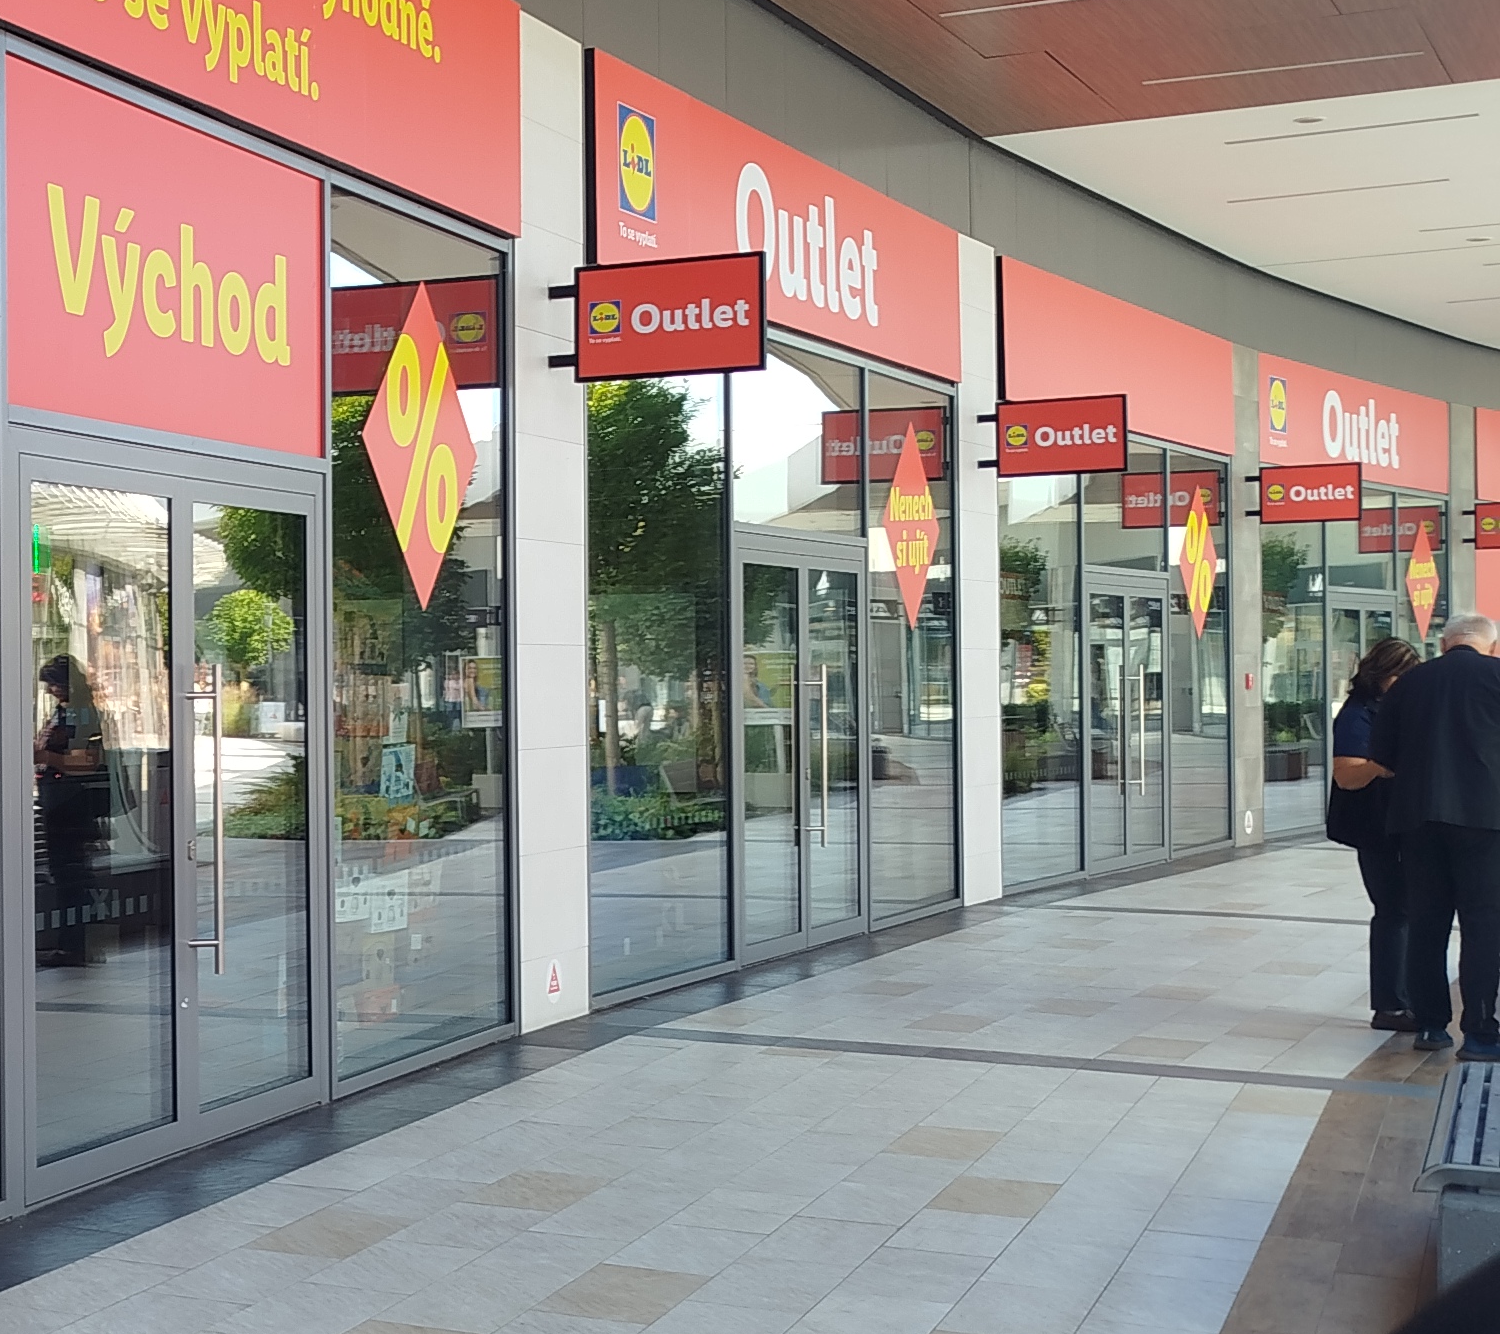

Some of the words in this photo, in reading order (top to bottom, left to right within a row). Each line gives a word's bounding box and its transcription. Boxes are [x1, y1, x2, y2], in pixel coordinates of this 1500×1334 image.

[619, 222, 627, 238] To
[735, 162, 879, 327] Outlet
[48, 184, 290, 365] Východ
[631, 298, 749, 334] Outlet
[1034, 423, 1117, 447] Outlet
[1323, 390, 1399, 469] Outlet
[889, 485, 934, 522] Nenech
[1289, 484, 1354, 502] Outlet
[896, 530, 908, 567] si
[908, 529, 930, 575] ujít
